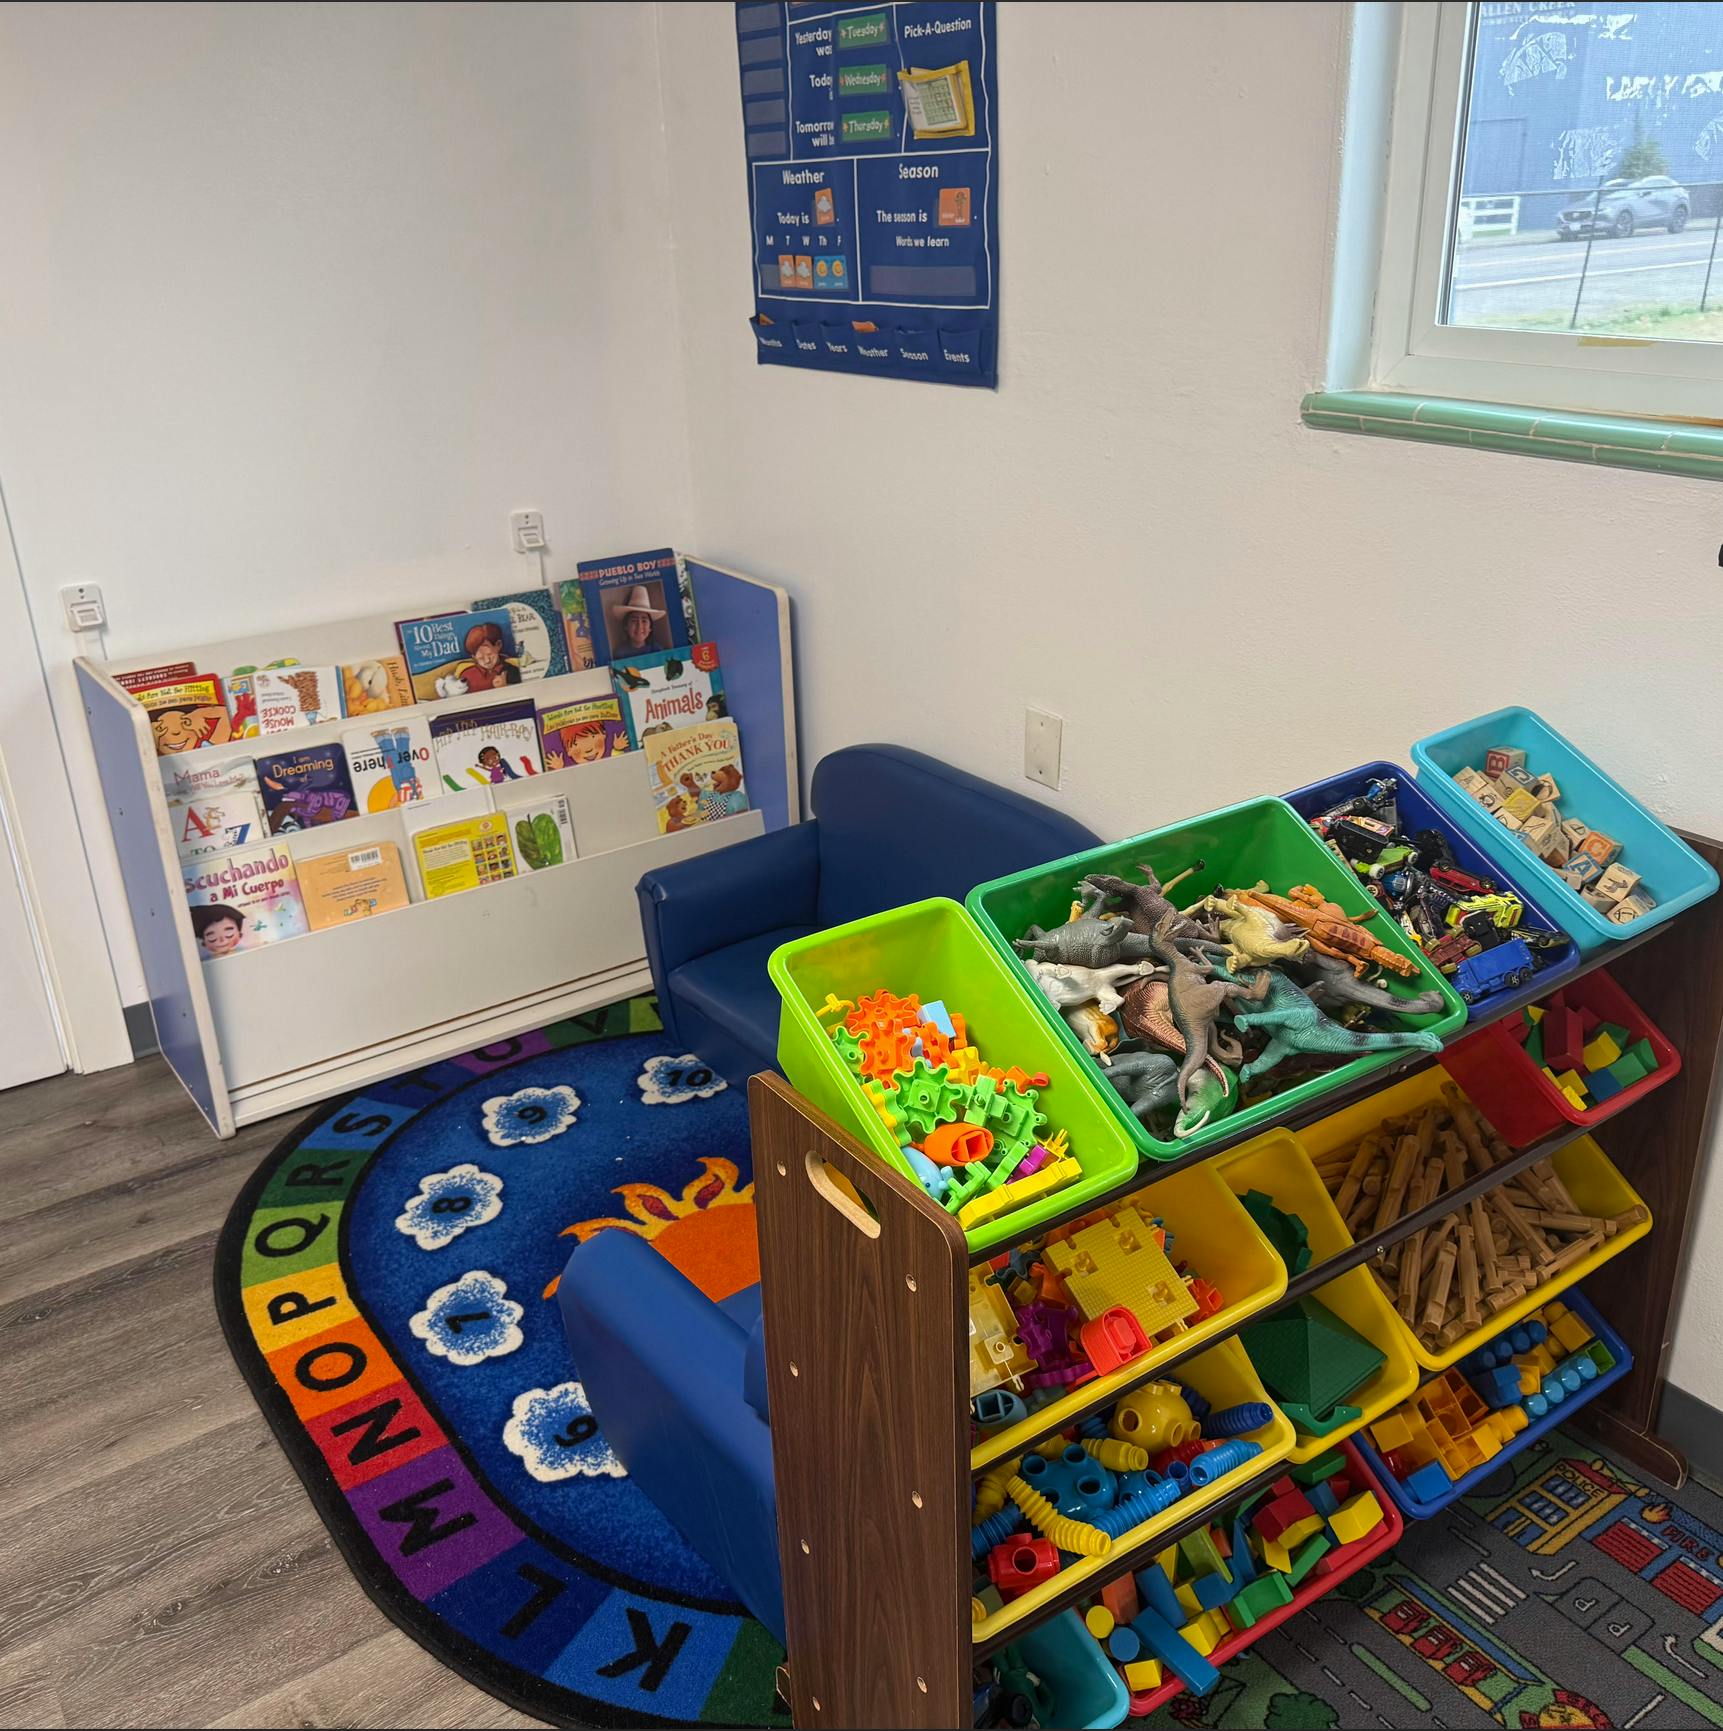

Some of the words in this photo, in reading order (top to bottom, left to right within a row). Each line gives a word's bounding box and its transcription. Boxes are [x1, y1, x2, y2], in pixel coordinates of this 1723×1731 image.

[847, 24, 878, 39] Tuesday
[904, 18, 972, 39] Pick-A-Question
[845, 72, 880, 87] Wednesday
[849, 119, 883, 133] Thursday
[782, 169, 824, 185] Weather
[898, 163, 939, 180] Season
[777, 212, 800, 227] Today
[801, 212, 810, 225] is
[876, 209, 892, 223] The
[893, 212, 916, 223] season
[919, 209, 928, 223] is
[766, 235, 774, 246] M
[785, 235, 791, 246] T
[802, 236, 810, 247] W
[818, 235, 828, 247] Th
[896, 236, 913, 247] Words
[914, 238, 925, 247] we
[927, 236, 950, 247] learn
[900, 348, 929, 361] Season
[944, 349, 970, 363] Events
[598, 564, 635, 579] PUEBLO
[637, 560, 657, 572] BOY
[413, 625, 433, 645] 10
[431, 622, 453, 633] Best
[432, 636, 460, 657] Dad
[261, 705, 297, 718] COOKIE
[645, 688, 704, 723] Animals
[262, 716, 295, 729] MOUSE
[353, 755, 396, 773] There
[398, 747, 430, 763] Over
[664, 745, 702, 772] THANK
[705, 739, 729, 751] YOU
[174, 769, 220, 785] Mama
[272, 759, 334, 778] Dreaming
[182, 806, 215, 842] A
[185, 848, 289, 894] scuchando
[209, 893, 218, 903] a
[223, 885, 238, 899] Mi
[241, 878, 284, 896] Cuerpo
[664, 1068, 712, 1088] 10
[332, 1111, 393, 1138] S
[517, 1104, 548, 1125] 9
[285, 1157, 353, 1188] R
[432, 1196, 473, 1215] 8
[254, 1212, 331, 1259] Q
[266, 1290, 339, 1326] P
[294, 1341, 368, 1392] O
[331, 1398, 421, 1467] N
[1554, 1464, 1606, 1498] POLICE
[378, 1478, 480, 1558] M
[1662, 1524, 1715, 1561] FIRE
[500, 1563, 567, 1640] L
[1574, 1598, 1597, 1613] P
[1608, 1622, 1632, 1638] P
[596, 1607, 693, 1693] K
